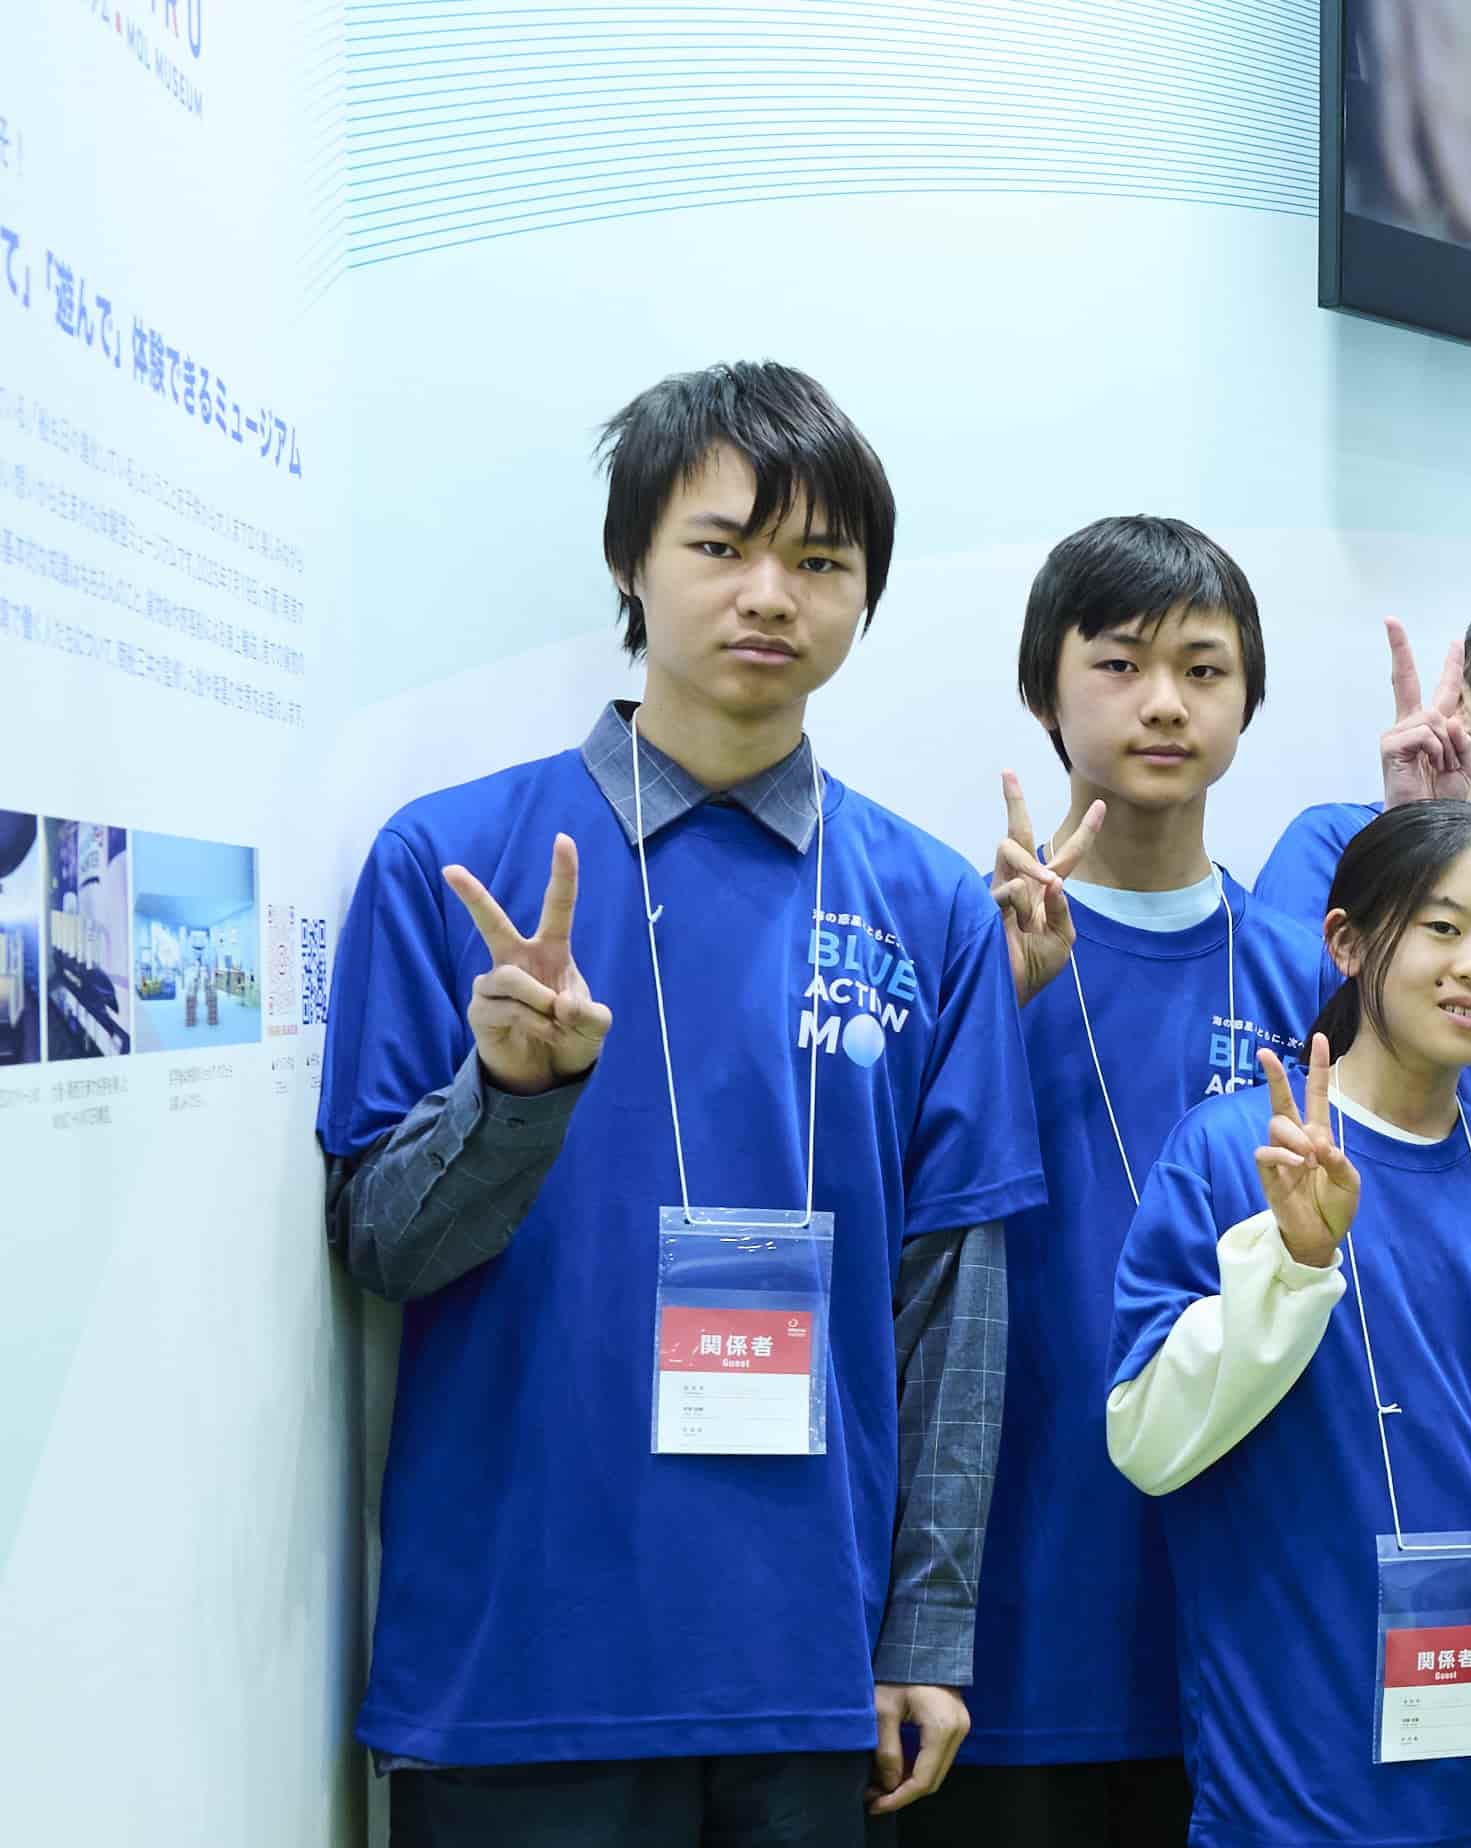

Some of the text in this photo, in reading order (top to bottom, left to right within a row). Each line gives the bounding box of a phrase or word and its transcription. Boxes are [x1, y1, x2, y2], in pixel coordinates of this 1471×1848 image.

[807, 929, 918, 1002] BLUE
[700, 1333, 774, 1357] 関係者
